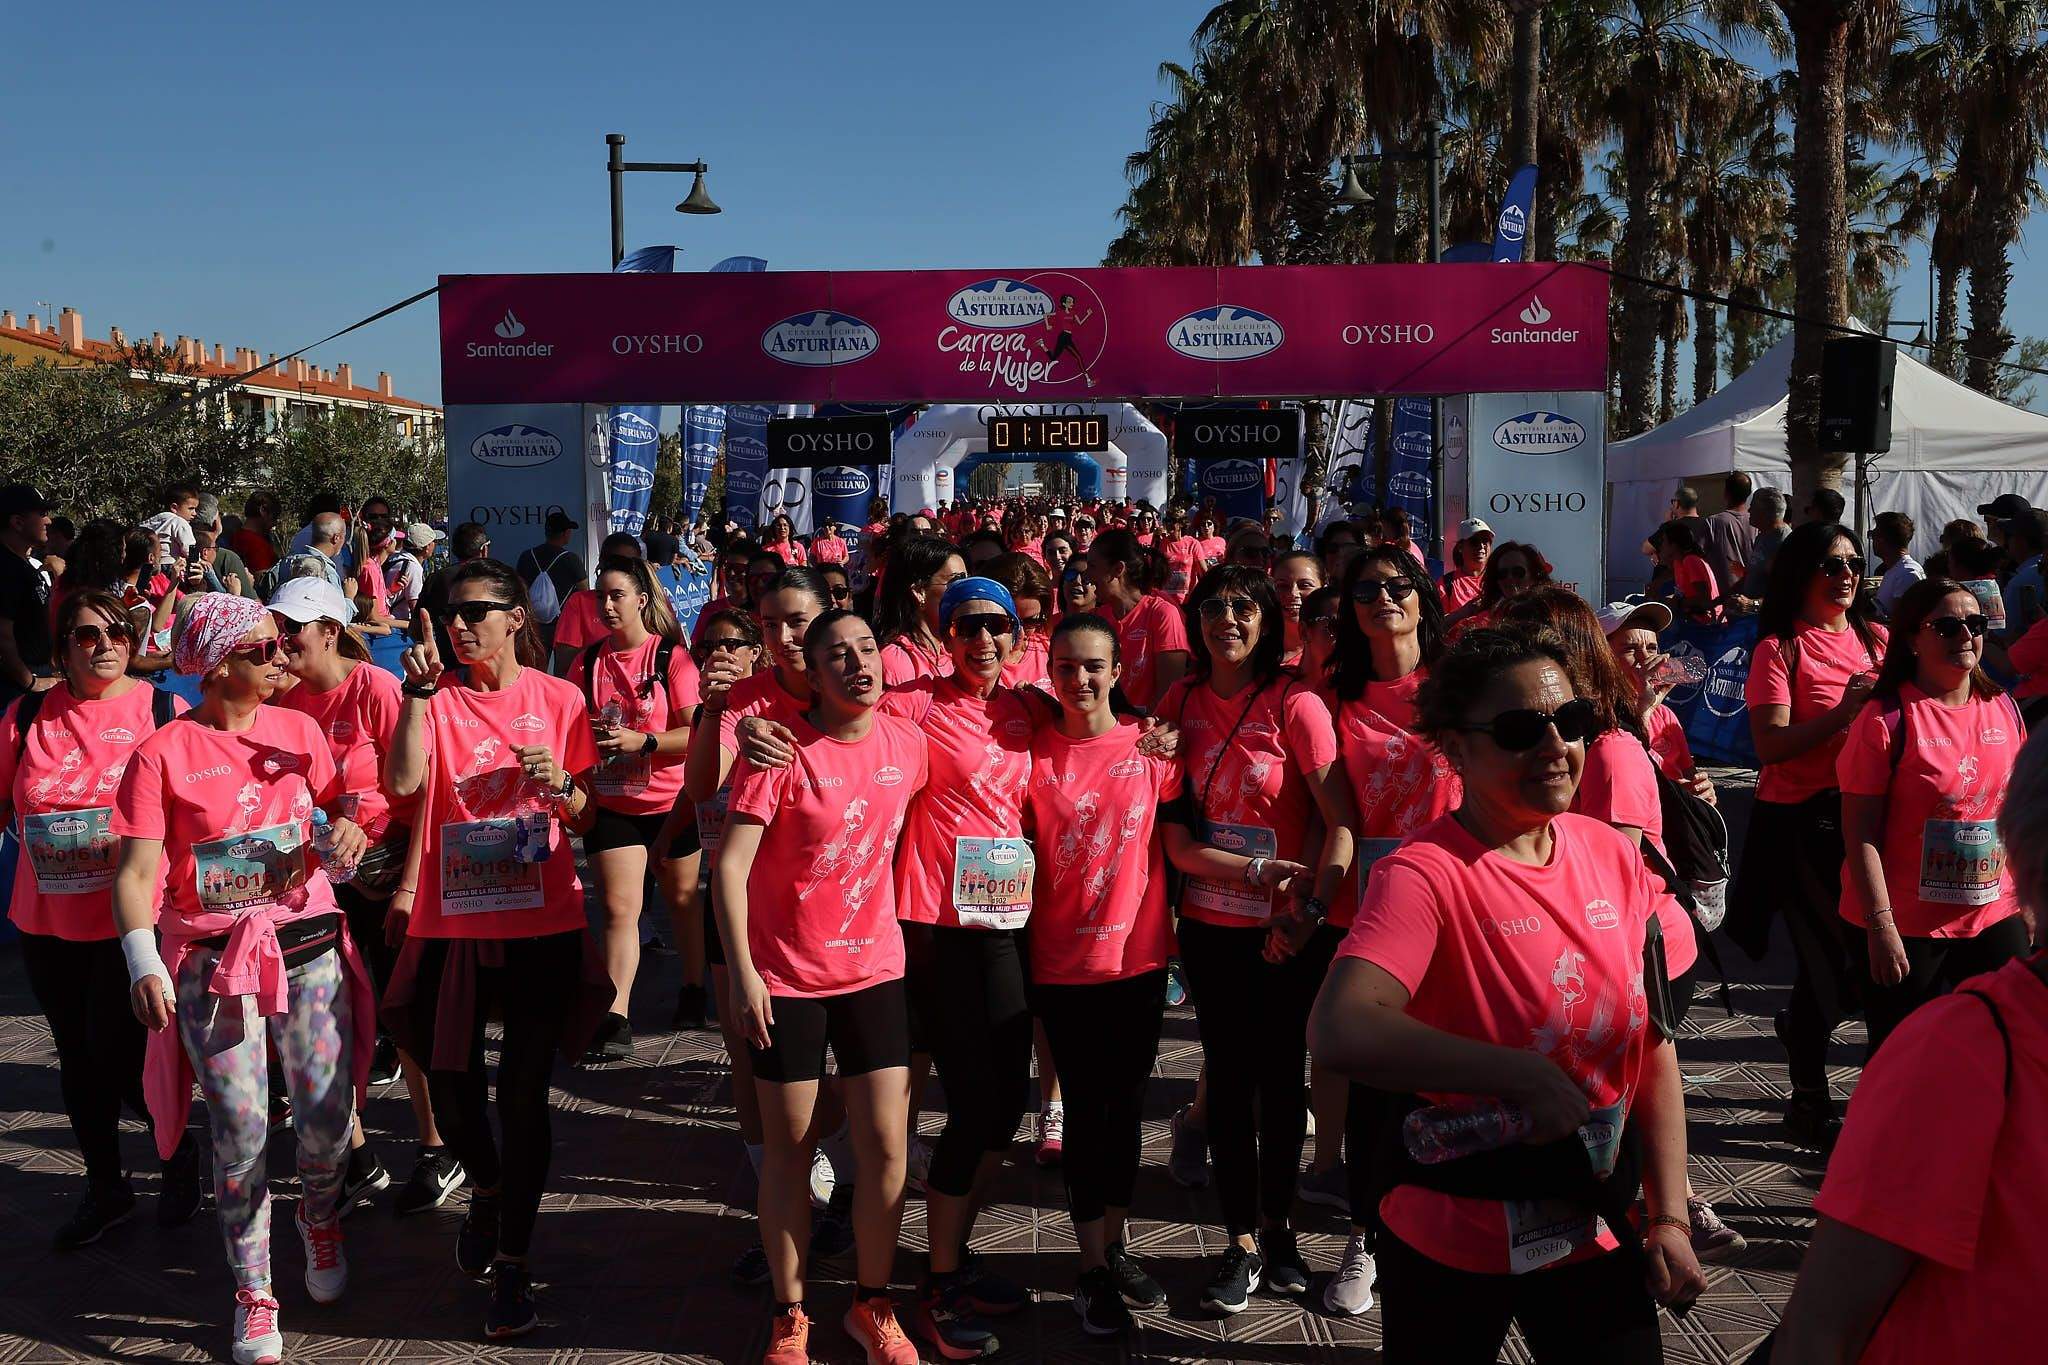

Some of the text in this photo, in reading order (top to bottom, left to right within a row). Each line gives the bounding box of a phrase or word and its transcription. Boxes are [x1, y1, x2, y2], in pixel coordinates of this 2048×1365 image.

[955, 298, 1046, 316] ASTURIANA
[771, 331, 870, 352] ASTURIANA
[938, 326, 1026, 352] Carrera
[1176, 326, 1275, 346] ASTURIANA
[1342, 324, 1434, 344] OYSHO
[1491, 328, 1579, 343] Santander
[466, 342, 554, 358] Santander
[612, 334, 704, 354] OYSHO
[959, 349, 1059, 392] de la Mujer
[914, 430, 946, 438] OYSHO
[996, 420, 1099, 446] 01:12:00
[1115, 425, 1147, 434] OYSHO
[1194, 424, 1281, 444] OYSHO
[1500, 429, 1579, 445] ASTURIANA
[478, 441, 556, 457] ASTURIANA
[788, 433, 873, 452] OYSHO
[815, 474, 866, 489] ASTURIANA
[900, 474, 930, 482] OYSHO
[1132, 470, 1162, 478] OYSHO
[1490, 492, 1586, 513] OYSHO
[43, 728, 72, 738] YSHO
[186, 765, 232, 783] OYSHO
[801, 776, 843, 789] OYSHO
[1957, 858, 1989, 872] 016
[986, 879, 1016, 893] 016
[451, 900, 483, 909] OYSHO
[1481, 916, 1541, 936] OSHO
[1582, 1130, 1612, 1142] RIANA
[1526, 1238, 1568, 1261] OYSHO
